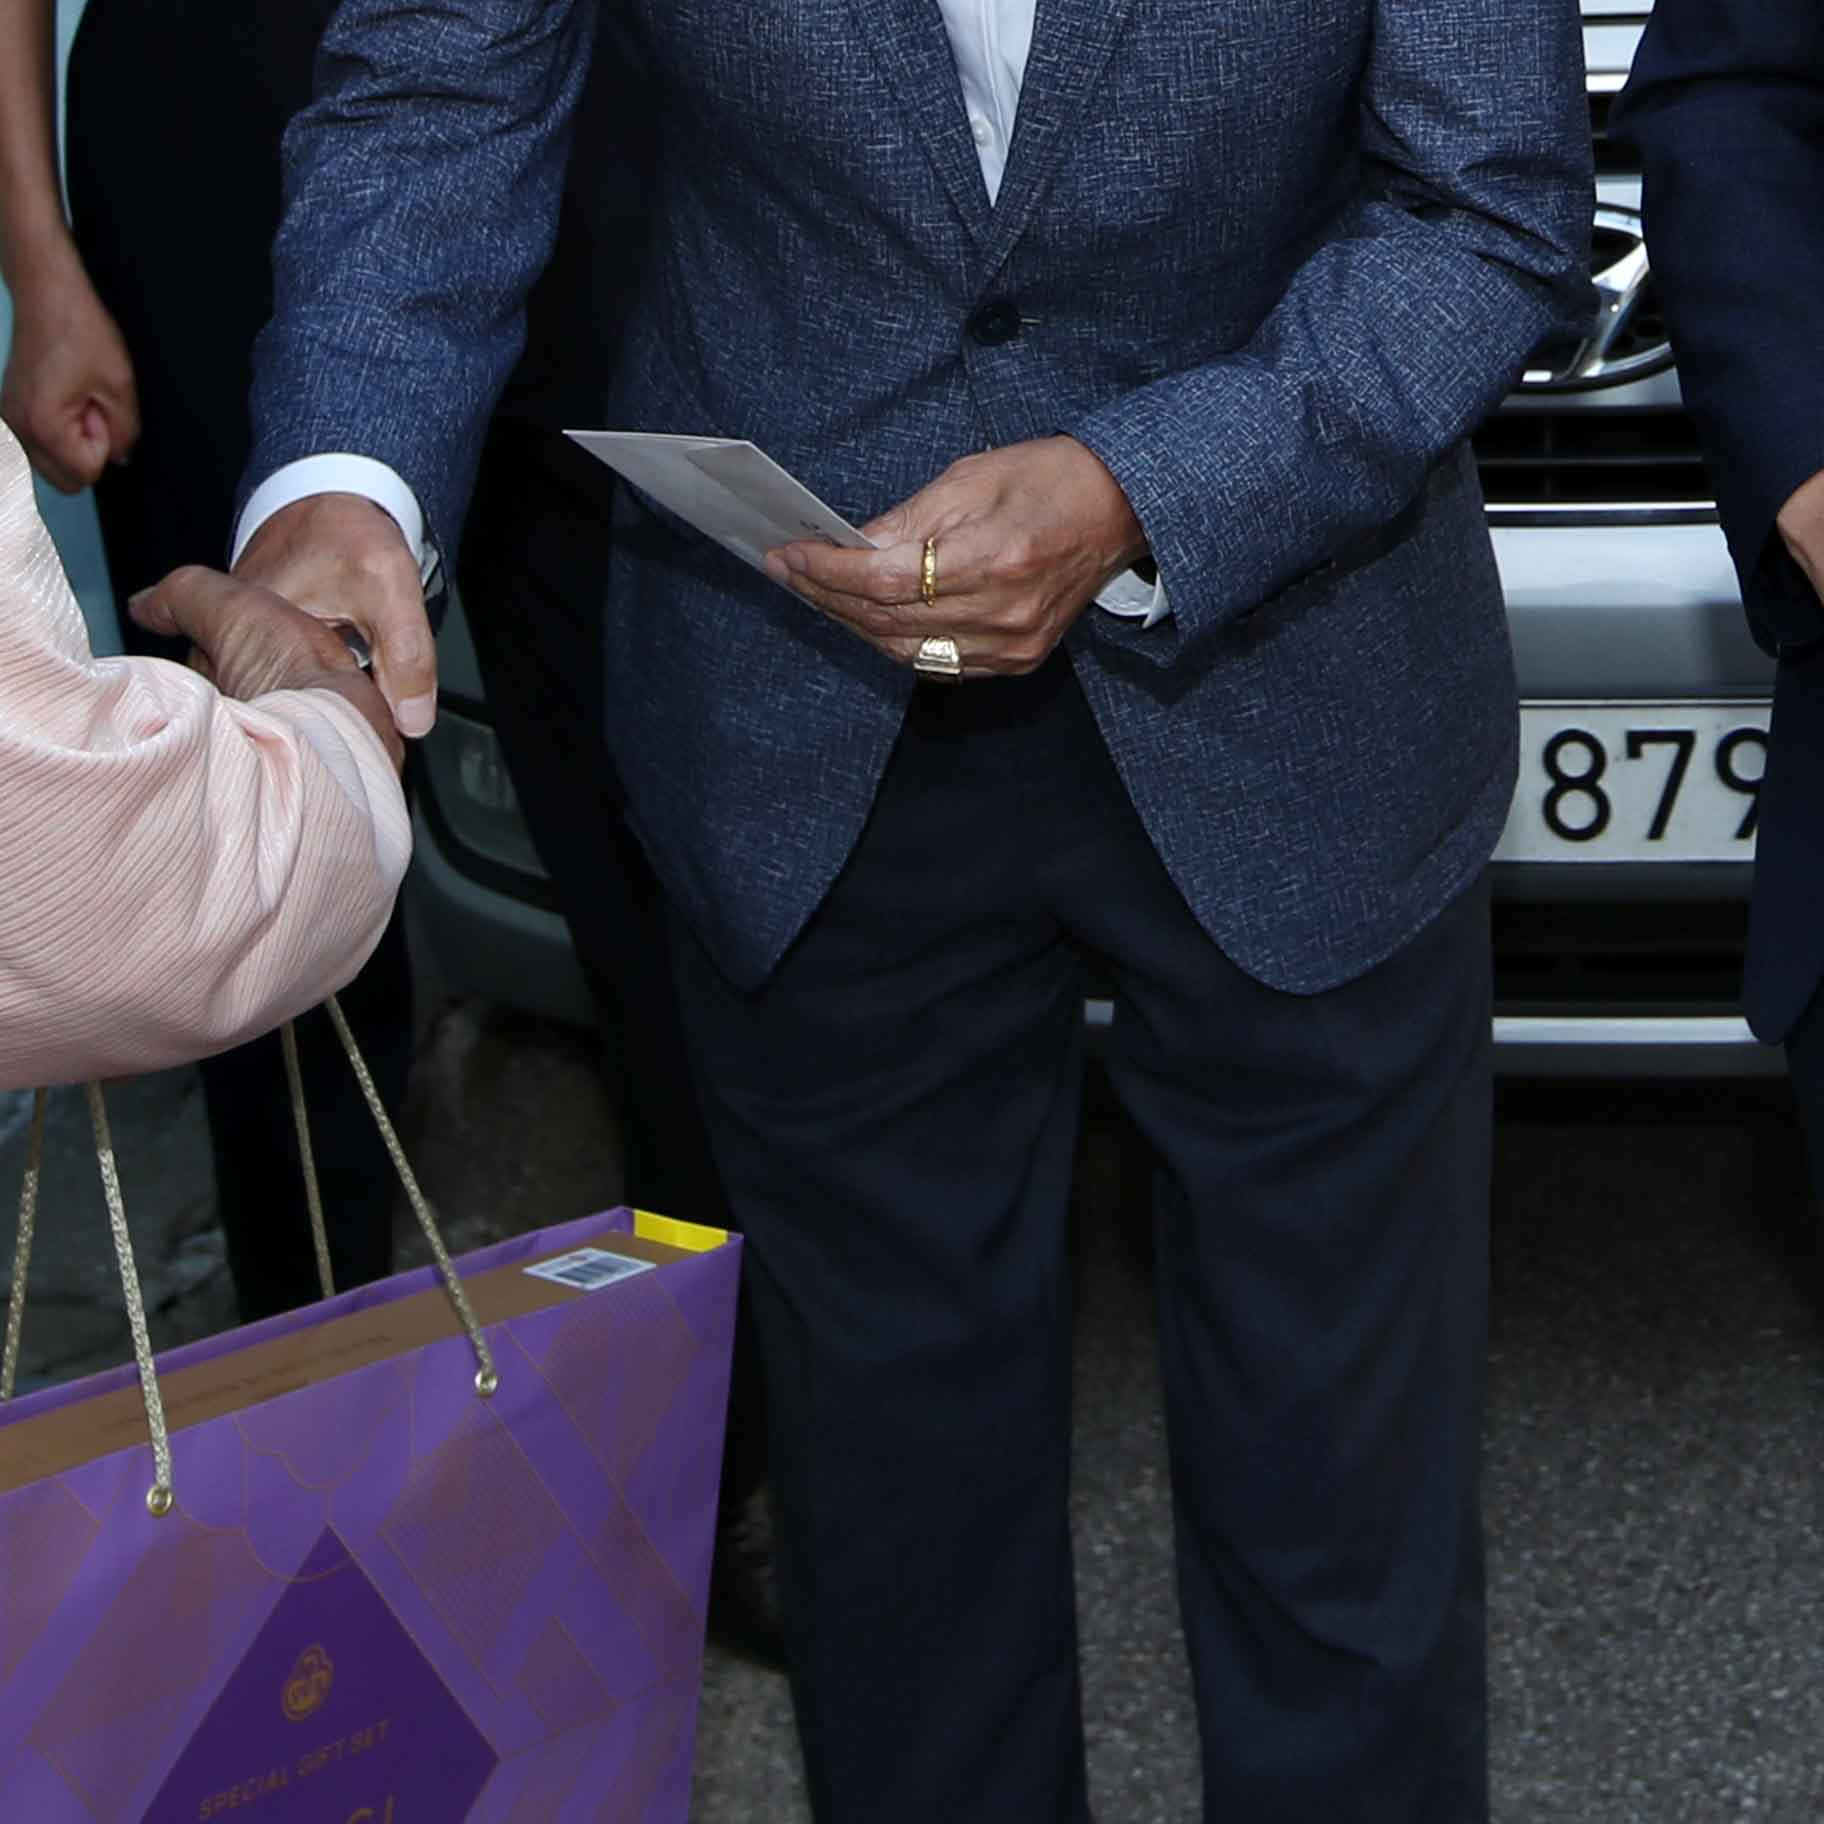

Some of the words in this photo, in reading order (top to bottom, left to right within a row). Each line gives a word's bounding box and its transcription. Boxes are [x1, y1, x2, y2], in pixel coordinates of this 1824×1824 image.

[197, 1767, 289, 1821] SPECIAL
[297, 1736, 346, 1776] GIFT
[350, 1718, 393, 1754] SET
